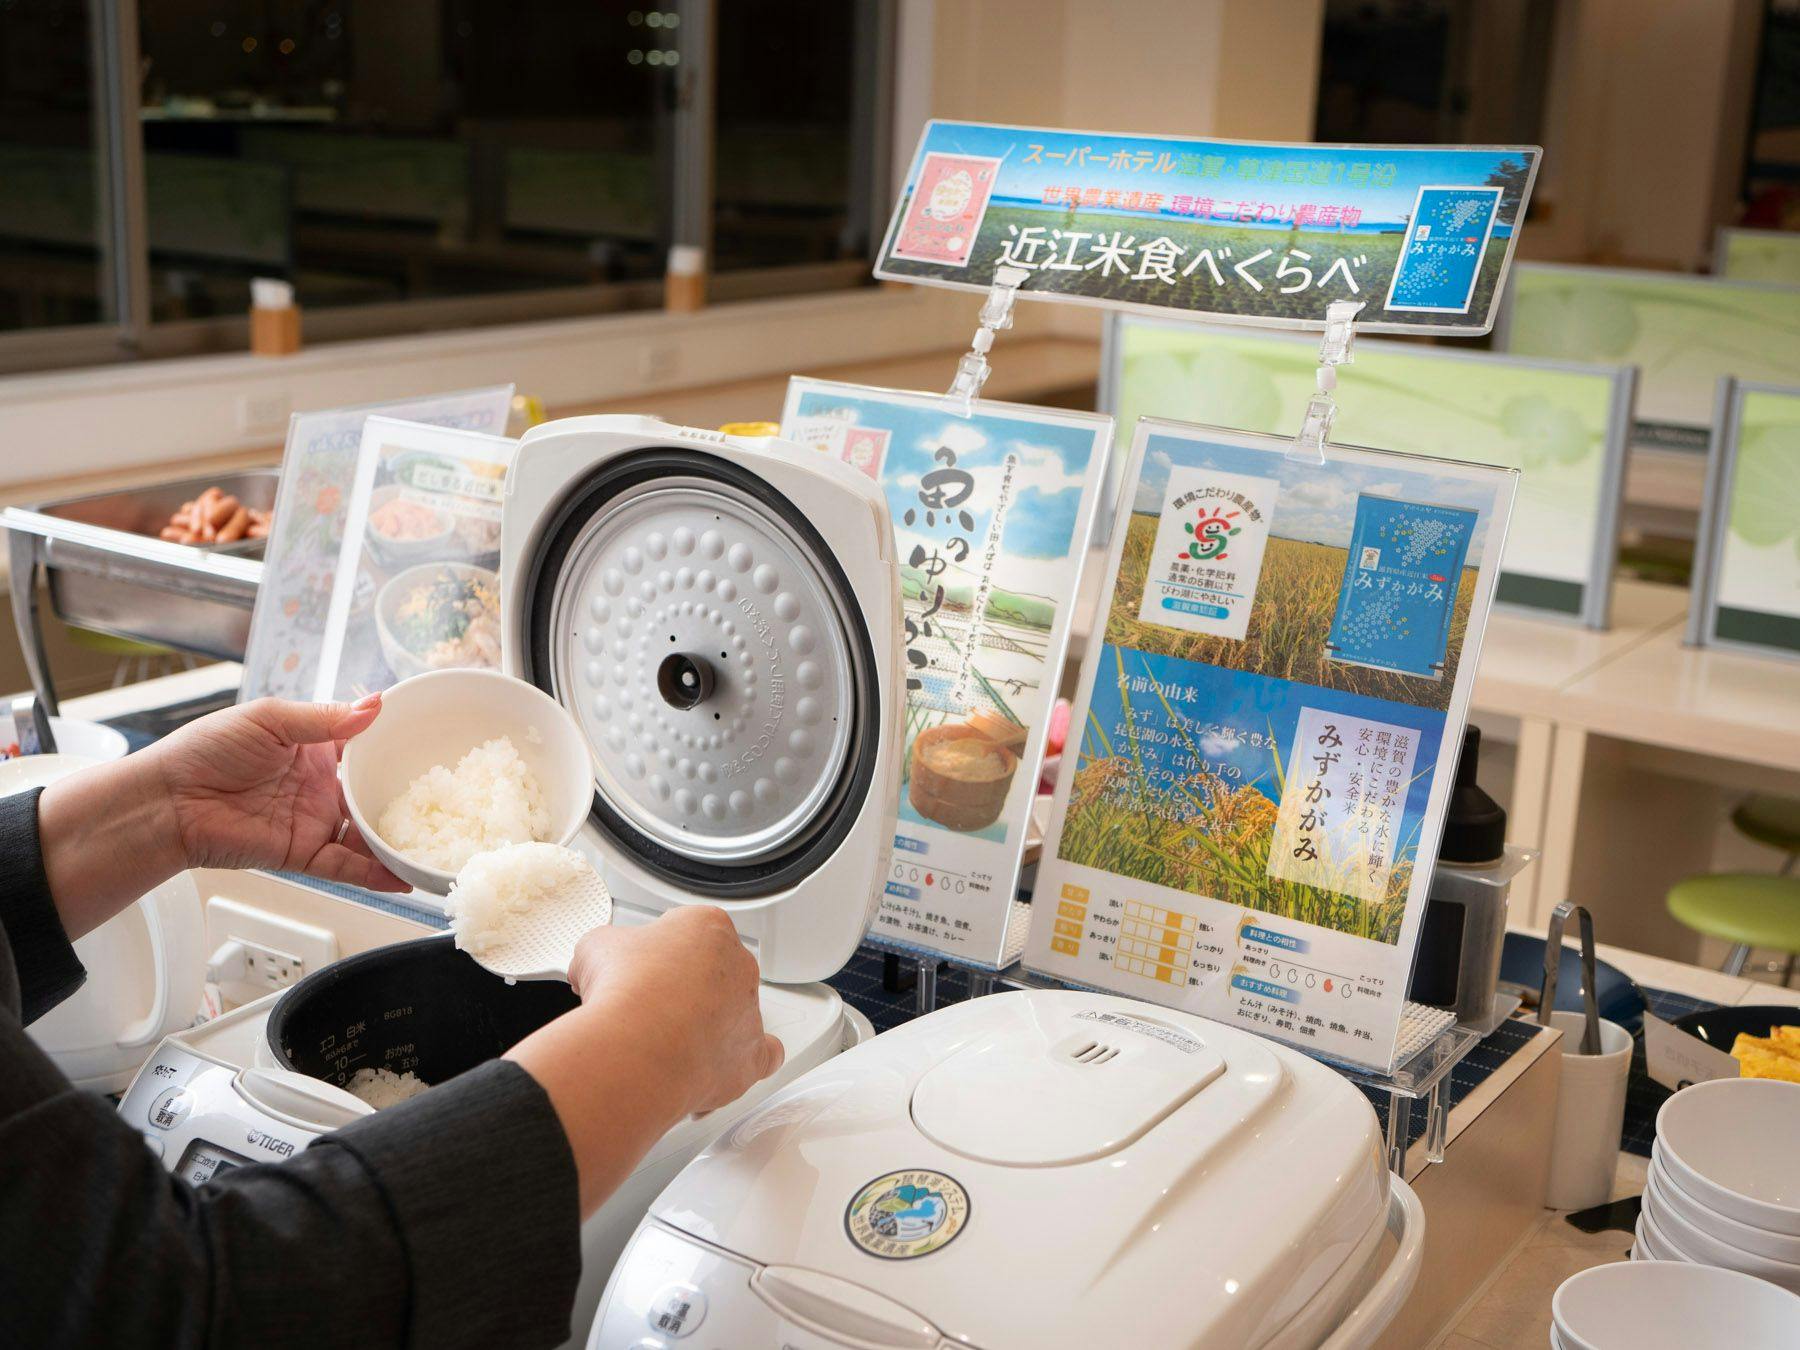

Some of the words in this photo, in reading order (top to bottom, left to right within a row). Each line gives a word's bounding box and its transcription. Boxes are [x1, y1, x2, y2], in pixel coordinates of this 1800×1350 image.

[1042, 185, 1165, 212] 世界農業遺産
[1171, 194, 1362, 227] 環境こだわり農産物
[995, 223, 1367, 294] 近江米食べくらべ
[1410, 242, 1475, 256] みずかがみ
[1168, 572, 1234, 592] 通常の5割以下
[1170, 562, 1236, 582] 農薬・化学肥料
[1161, 585, 1235, 605] びわ湖にやさしい
[1354, 572, 1443, 601] みずかがみ
[1117, 672, 1198, 703] 名前の由来
[1342, 727, 1373, 815] 安心・安全米
[1358, 731, 1392, 834] 環境にこだわる
[1293, 724, 1342, 862] みずかがみ
[1367, 734, 1410, 883] 滋賀の豊かな水に輝く
[1093, 913, 1120, 927] やわらか
[1196, 942, 1223, 955] しっかり
[1244, 943, 1269, 955] あっさり
[1250, 929, 1297, 949] 料理との相性
[1193, 960, 1220, 973] もっちり
[1359, 974, 1385, 986] こってり
[346, 1020, 366, 1038] 白米
[335, 1056, 348, 1071] 10
[338, 1072, 346, 1085] 9
[259, 1134, 296, 1158] TIGER
[193, 1171, 209, 1183] 白米
